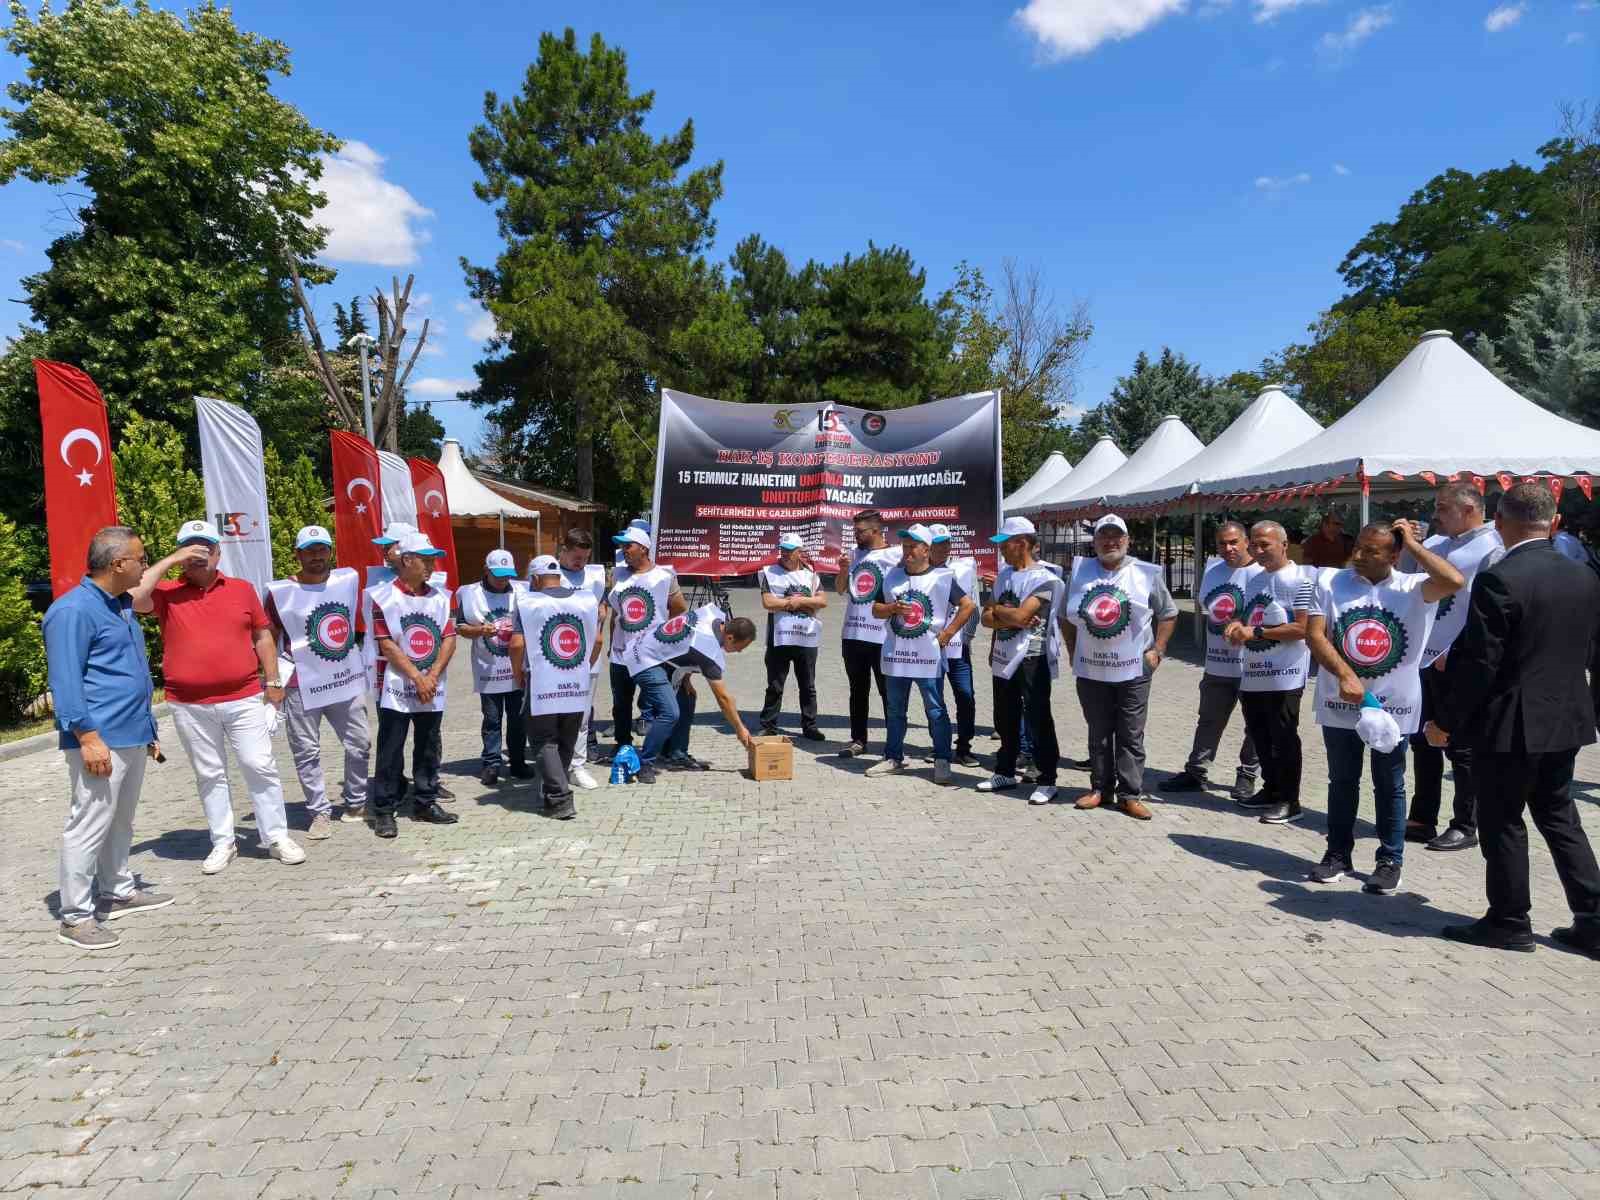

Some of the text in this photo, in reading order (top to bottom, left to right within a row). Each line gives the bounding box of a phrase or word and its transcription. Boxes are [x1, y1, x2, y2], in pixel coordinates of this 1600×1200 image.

[717, 449, 942, 468] HAK-İŞ KONFEDERASYONU
[678, 471, 691, 484] 15
[694, 471, 739, 486] TEMMUZ
[869, 469, 966, 489] UNUTMAYACAĞIZ,
[697, 505, 755, 518] ŞEHİTLERİMİZİ
[757, 509, 768, 518] VE
[912, 508, 957, 518] ANIYORUZ
